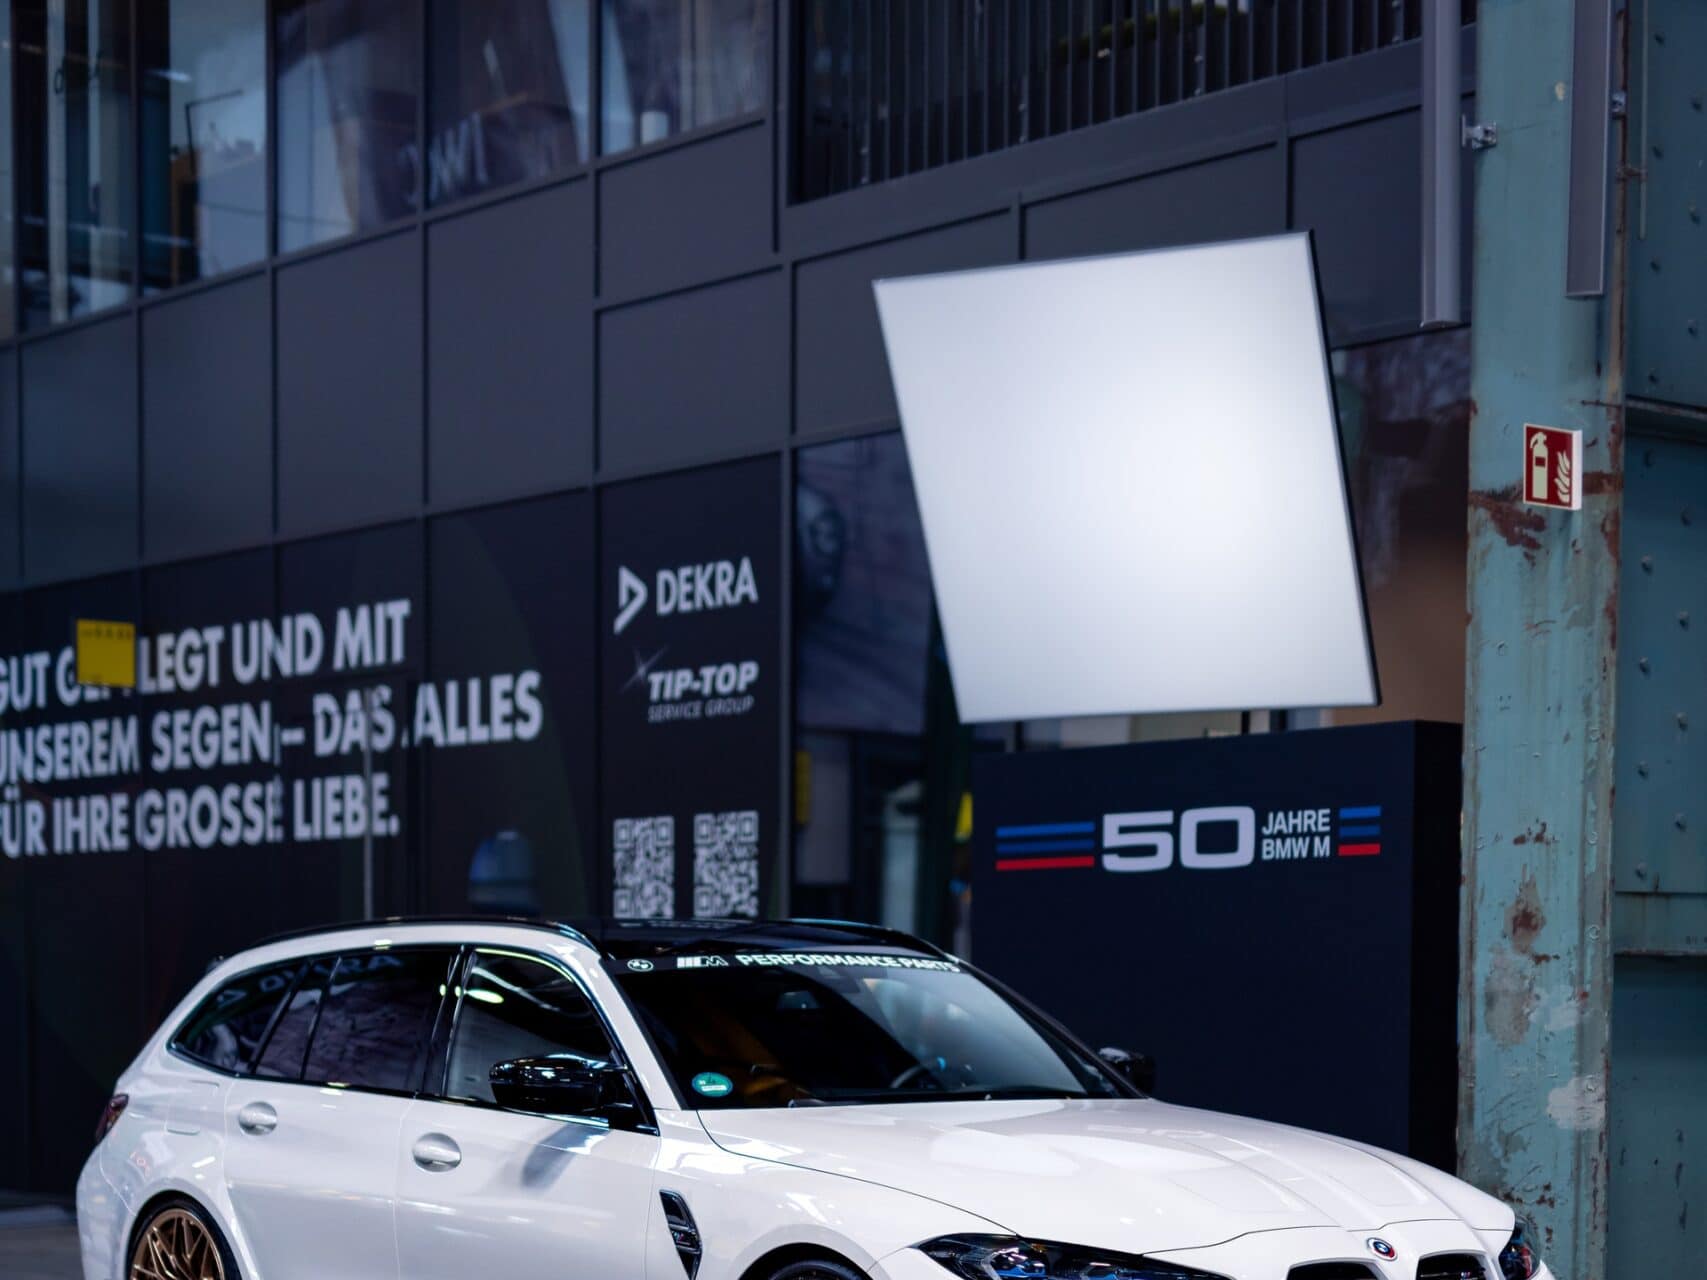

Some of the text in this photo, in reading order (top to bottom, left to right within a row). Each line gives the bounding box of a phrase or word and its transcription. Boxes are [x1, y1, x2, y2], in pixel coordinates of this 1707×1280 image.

[656, 556, 759, 615] DEKRA
[55, 626, 224, 707] GLEGT
[232, 613, 325, 684] UND
[333, 599, 411, 670] MIT
[647, 661, 759, 700] TIP-TOP
[150, 701, 276, 773] SEGEN
[312, 684, 395, 757] DAS
[402, 670, 545, 748] ALLES
[647, 695, 755, 723] SERVICE GROUP
[0, 770, 401, 860] ÜR IHRE GROSSE LIEBE.
[1102, 805, 1256, 873] 50
[1261, 808, 1331, 836] JAHRE
[1261, 835, 1331, 861] BMW M
[735, 953, 900, 969] PERFORMANCE
[901, 957, 961, 973] PARTS
